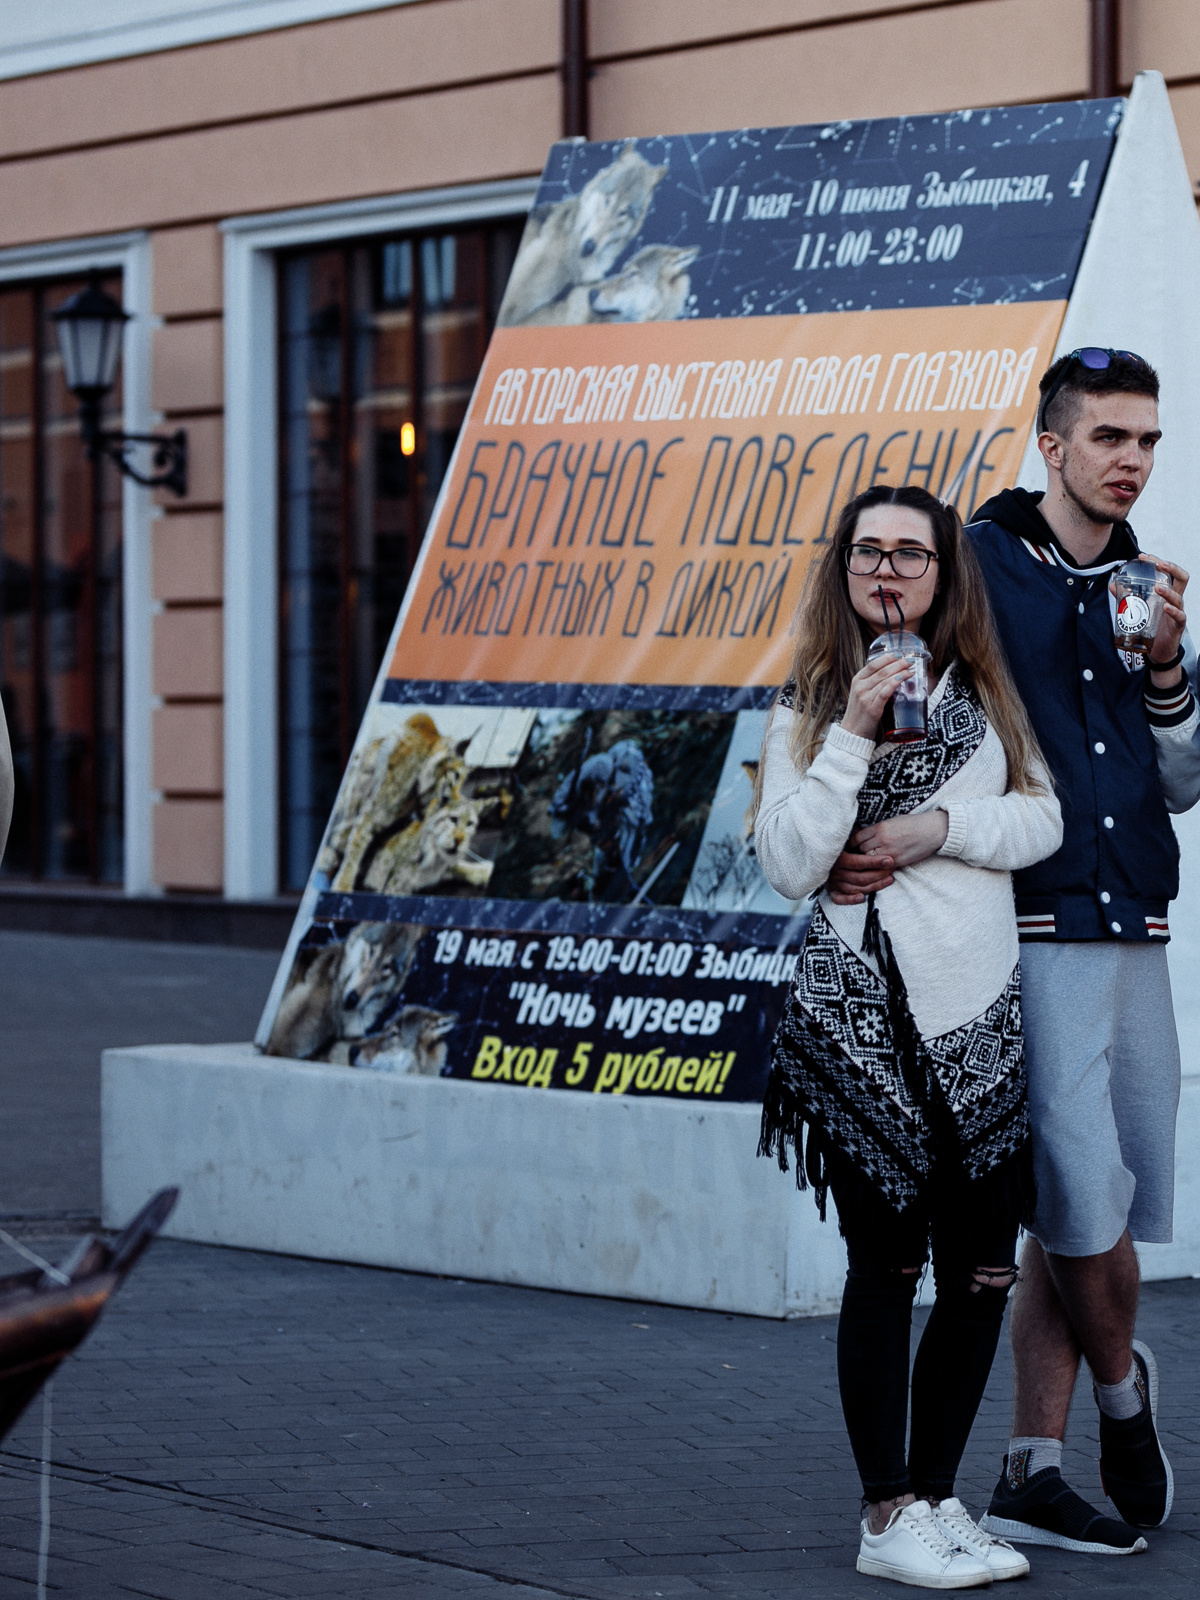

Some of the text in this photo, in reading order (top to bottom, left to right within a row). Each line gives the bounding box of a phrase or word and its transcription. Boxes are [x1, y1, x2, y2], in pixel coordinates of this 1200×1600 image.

[707, 185, 740, 223] 11
[840, 184, 911, 215] июня
[916, 166, 1054, 212] Зыбицкая,
[1068, 159, 1090, 198] 4
[793, 223, 964, 271] 11:00-23:00
[484, 346, 1037, 425] АВТОРСКАЯ ВЫСТАВКА ПАВЛА ГЛАЗКОВА
[446, 437, 685, 549] БРАЧНОЕ
[421, 557, 624, 638] ЖИВОТНЫХ
[622, 558, 655, 638] В
[655, 551, 792, 639] ДИКОЙ
[434, 929, 463, 965] 19
[465, 937, 514, 968] мая
[520, 940, 540, 969] с
[544, 935, 694, 978] 19:00-01:00
[508, 981, 746, 1039] "Ночь музеев"
[471, 1036, 737, 1095] Вход 5 рублей!
